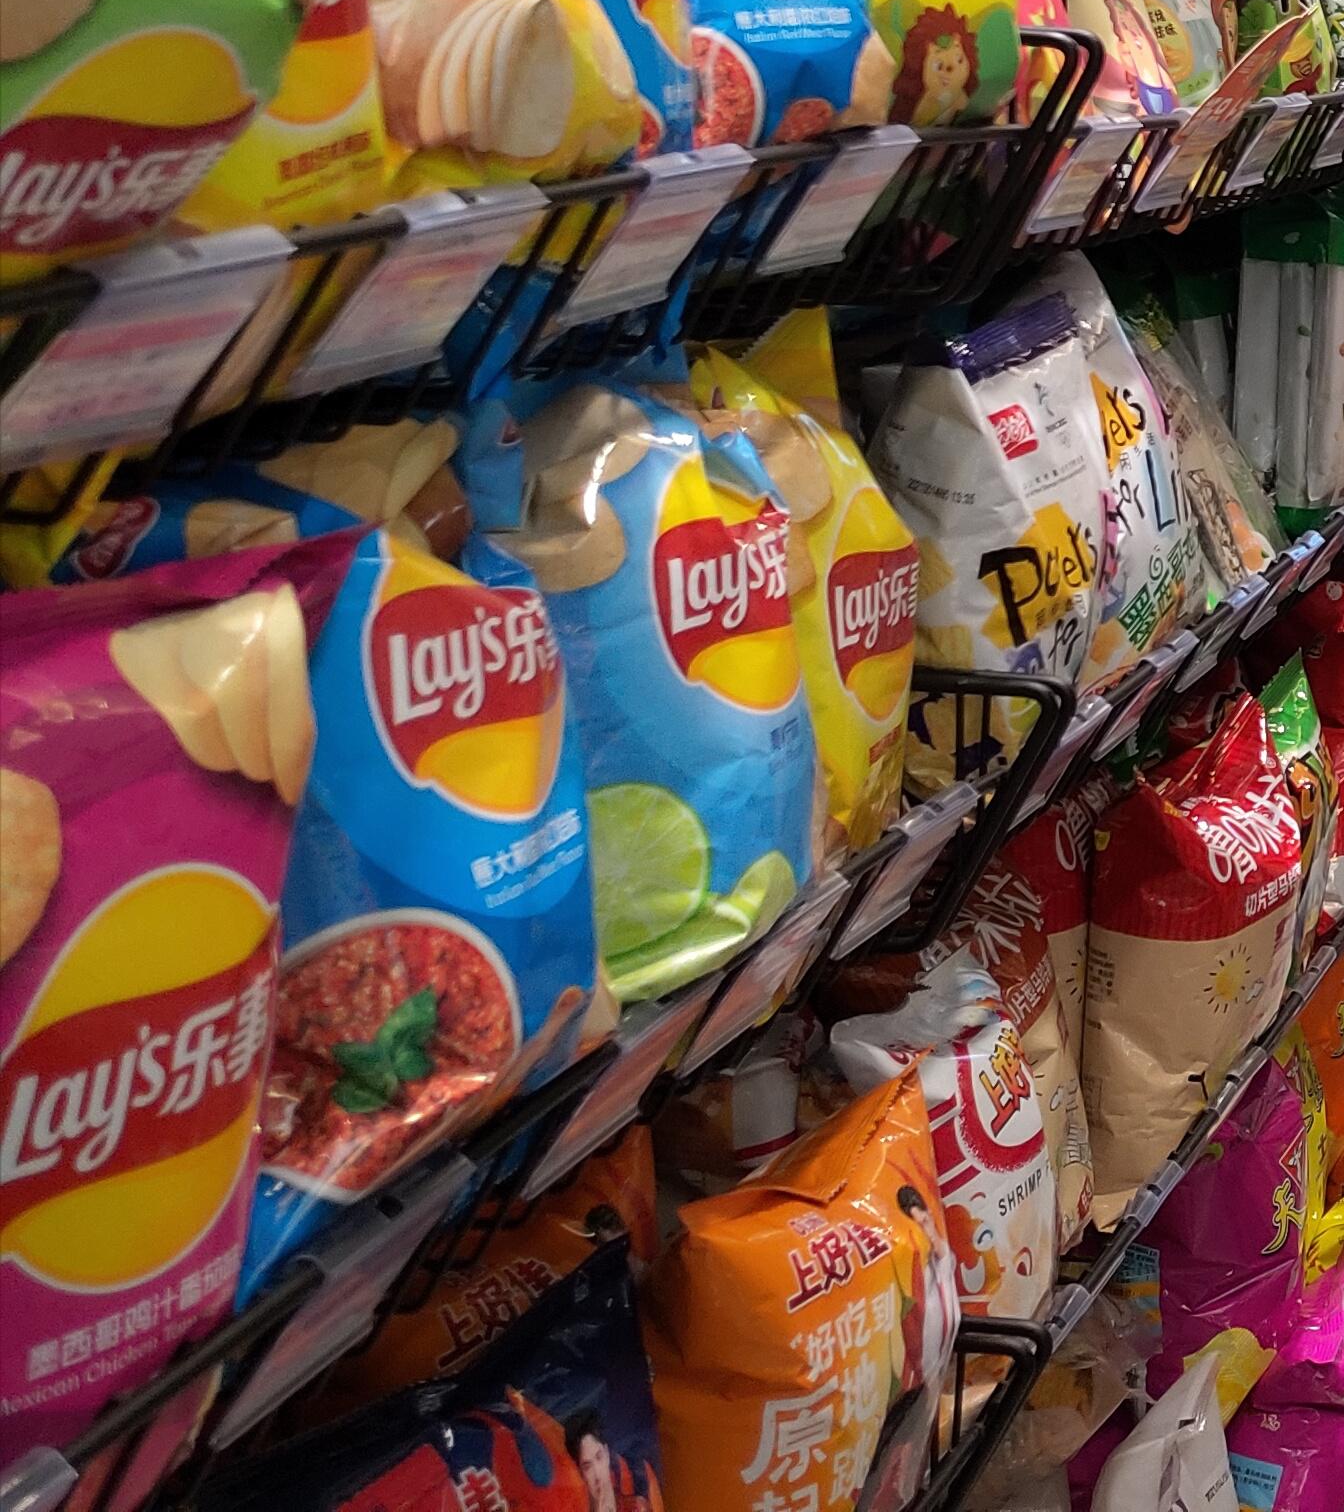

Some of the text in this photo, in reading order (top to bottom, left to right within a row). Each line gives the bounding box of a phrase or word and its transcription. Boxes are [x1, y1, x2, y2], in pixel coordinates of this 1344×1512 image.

[667, 534, 761, 636] Lay's
[836, 573, 890, 648] Lay's
[388, 606, 503, 726] Lay's
[0, 1025, 163, 1184] Lay's
[998, 1169, 1043, 1217] SHRIMP
[787, 1220, 894, 1313] 上好佳
